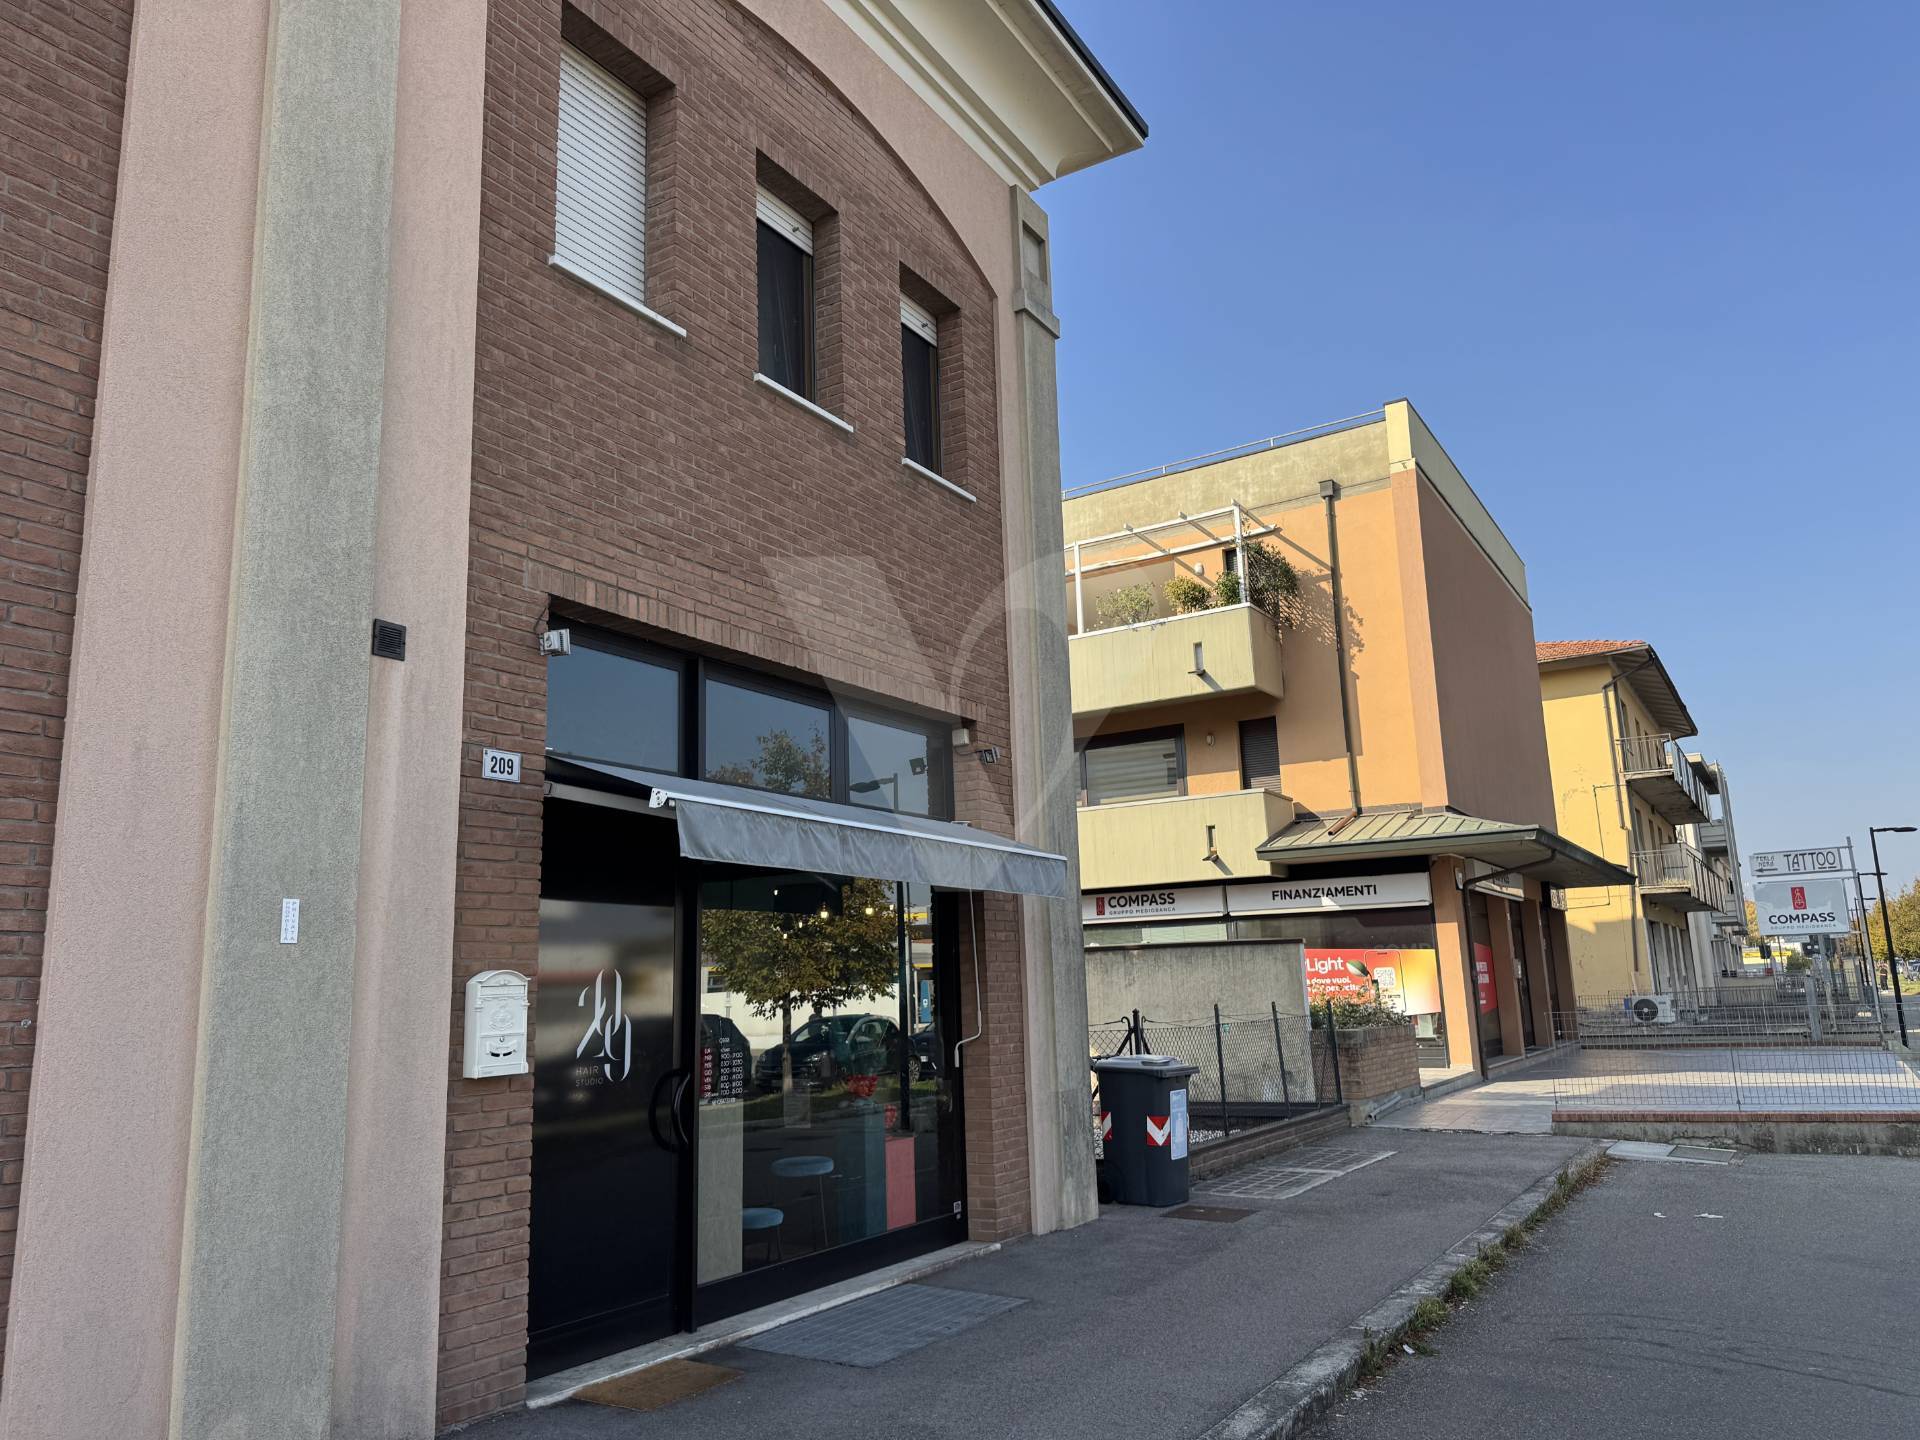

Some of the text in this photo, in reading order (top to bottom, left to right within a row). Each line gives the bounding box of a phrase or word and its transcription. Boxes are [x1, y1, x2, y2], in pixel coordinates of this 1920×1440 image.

[491, 756, 513, 775] 209
[1783, 851, 1836, 871] TATTOO
[1108, 892, 1175, 908] COMPASS
[1272, 884, 1377, 901] FINANZIAMENTI
[1768, 911, 1836, 925] COMPASS
[1305, 956, 1344, 974] Light
[576, 1066, 599, 1077] HAIR
[575, 1077, 604, 1087] STUDIO
